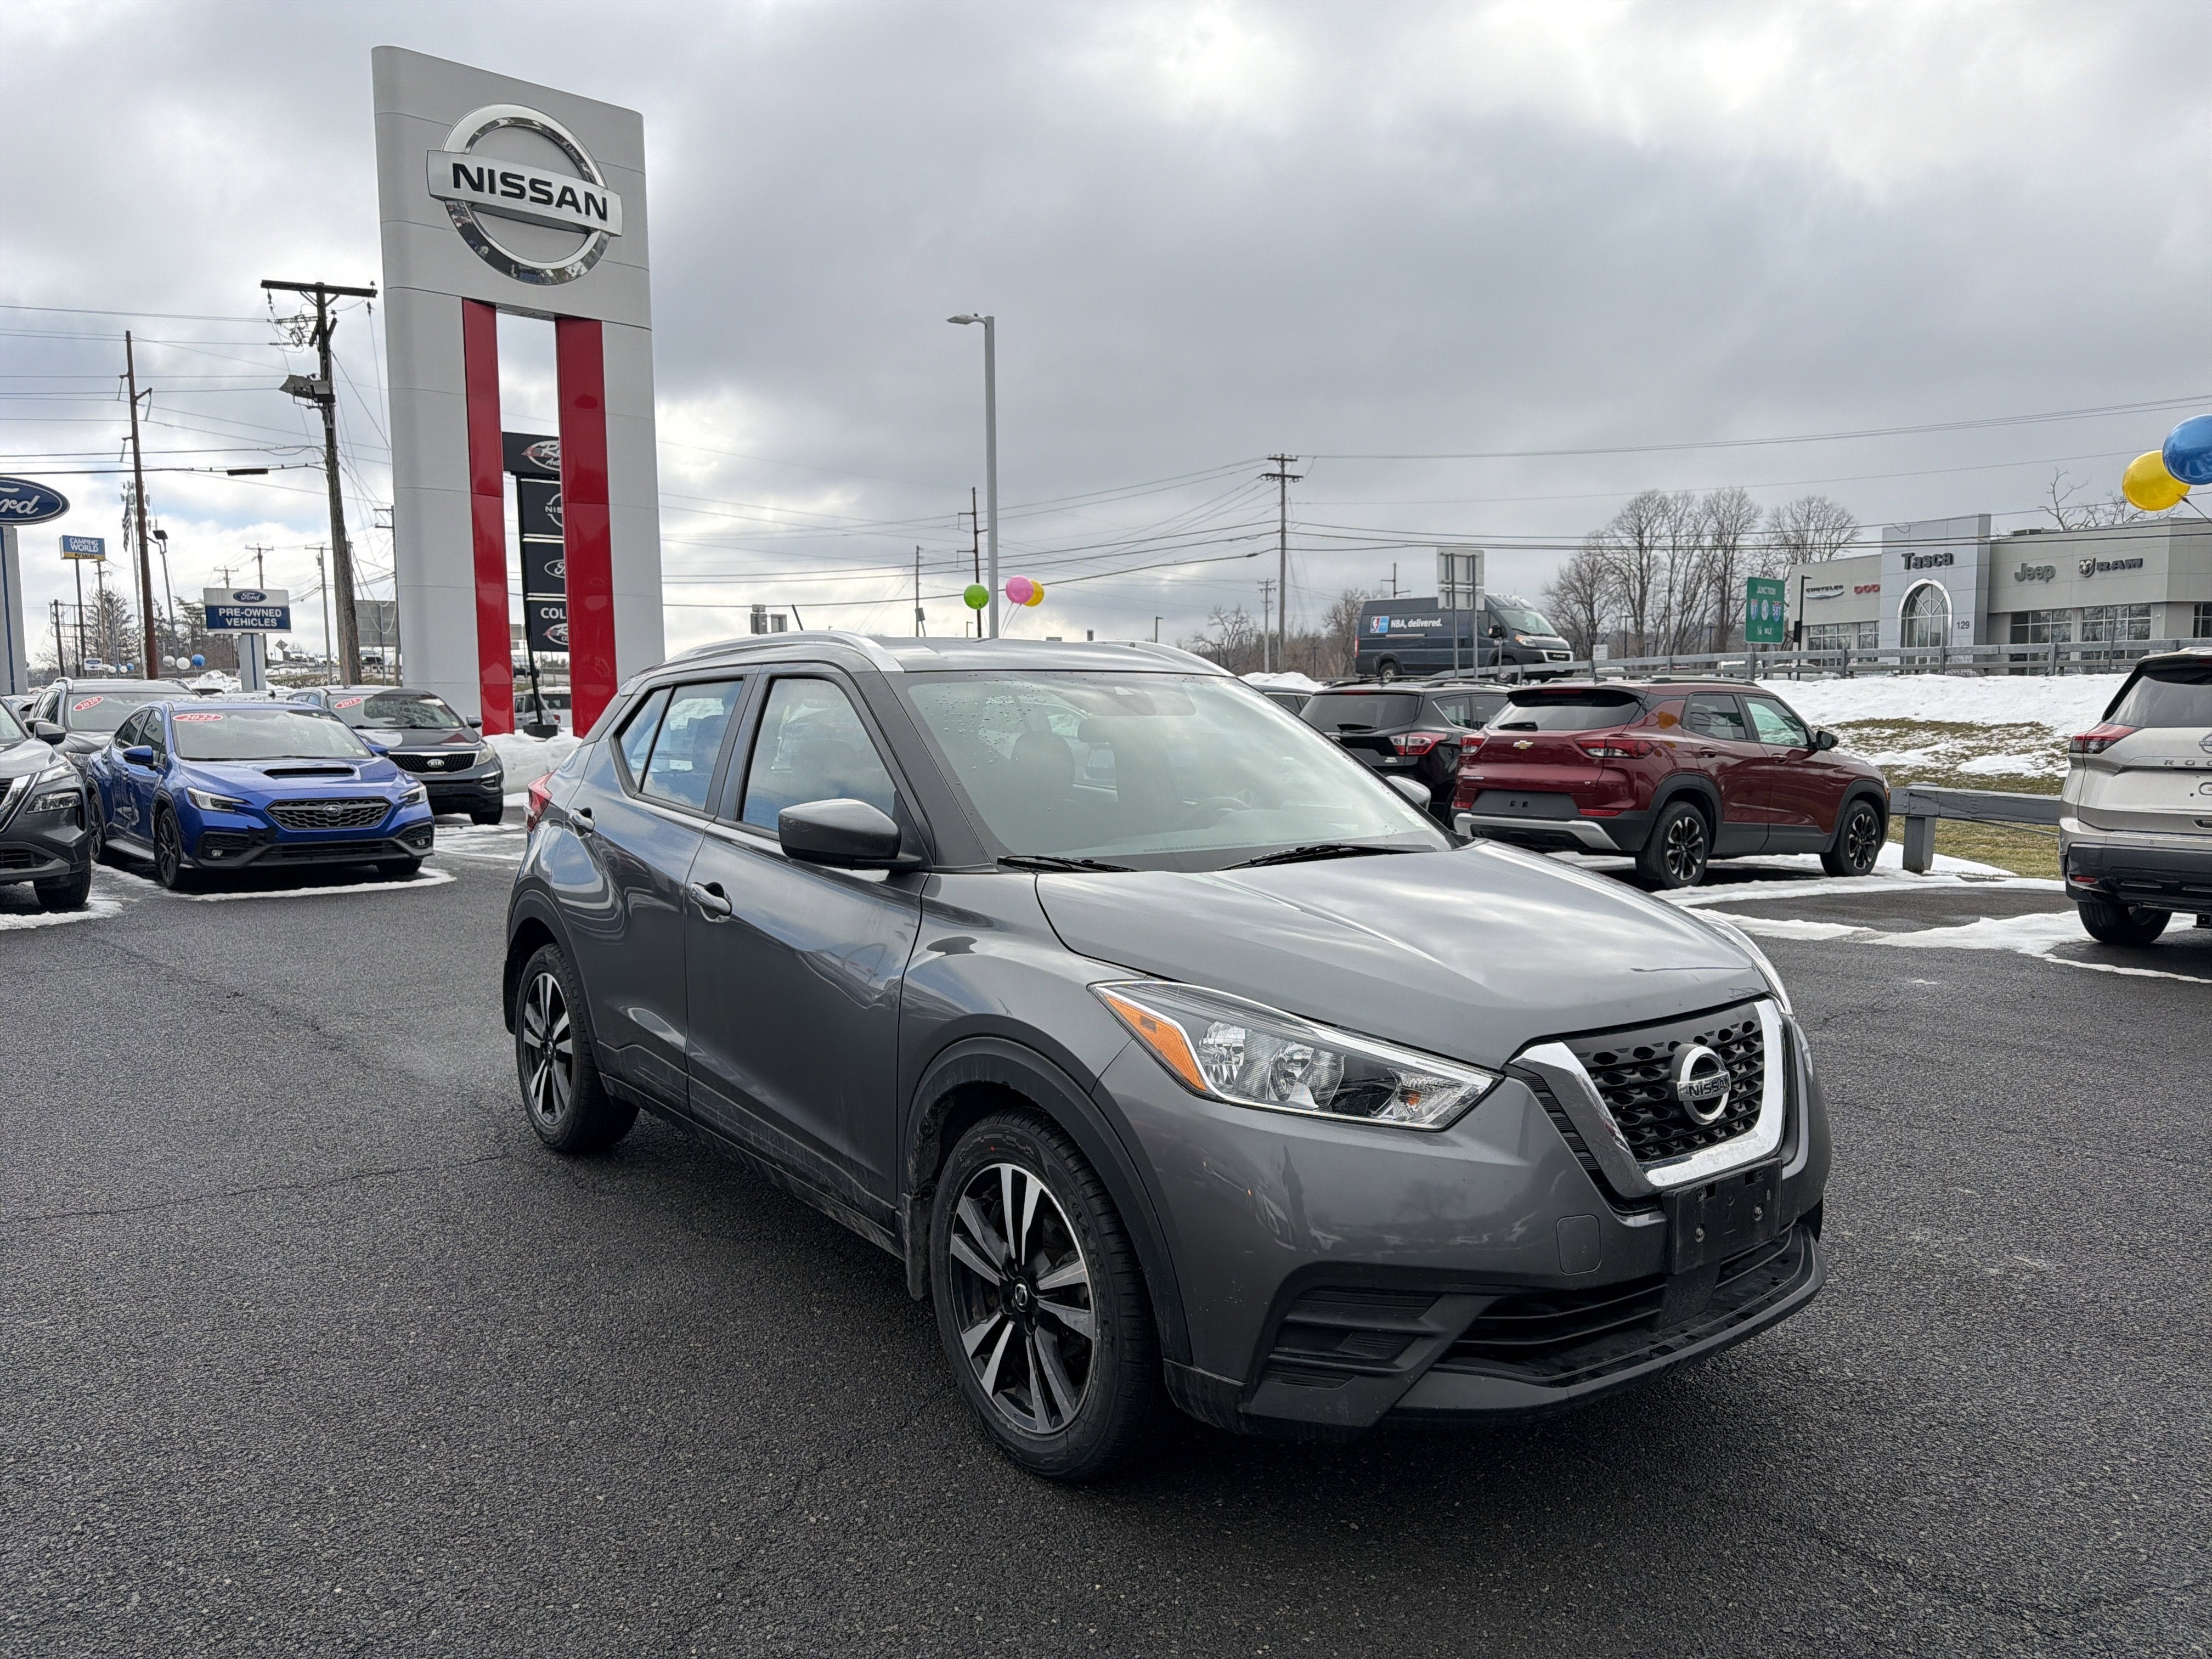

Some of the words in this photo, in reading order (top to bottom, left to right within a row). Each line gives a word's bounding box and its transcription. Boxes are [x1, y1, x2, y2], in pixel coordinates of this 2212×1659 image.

[452, 162, 607, 221] NISSAN
[69, 538, 98, 546] CAMPING
[70, 543, 98, 552] WORLD
[1901, 552, 1954, 571] Tasca
[2096, 558, 2143, 572] RAM
[2014, 562, 2056, 583] Jeep
[1805, 584, 1844, 594] CHRYSLER
[240, 592, 260, 601] Ford
[218, 608, 282, 617] PRE-OWNED
[225, 618, 277, 627] VEHICLES
[1391, 619, 1407, 629] NBA,
[1408, 618, 1443, 628] delivered.
[1956, 621, 1970, 630] 129
[78, 697, 99, 708] 2020
[1689, 1078, 1730, 1097] NISSAN
